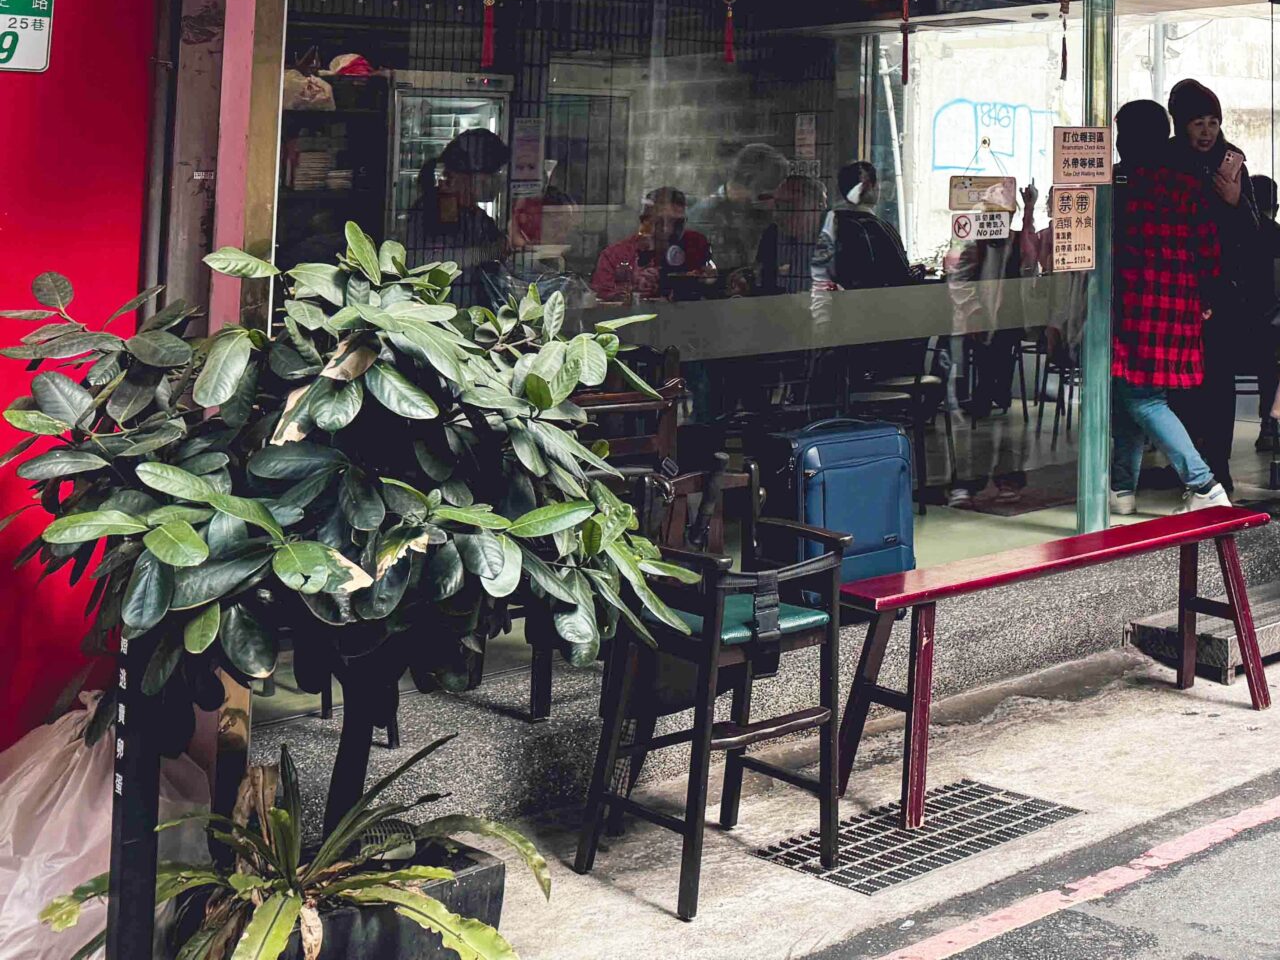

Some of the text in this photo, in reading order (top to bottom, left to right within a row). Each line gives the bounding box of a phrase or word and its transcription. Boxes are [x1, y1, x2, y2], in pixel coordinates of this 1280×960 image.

[8, 17, 45, 31] 25巷
[976, 228, 1003, 237] No pet
